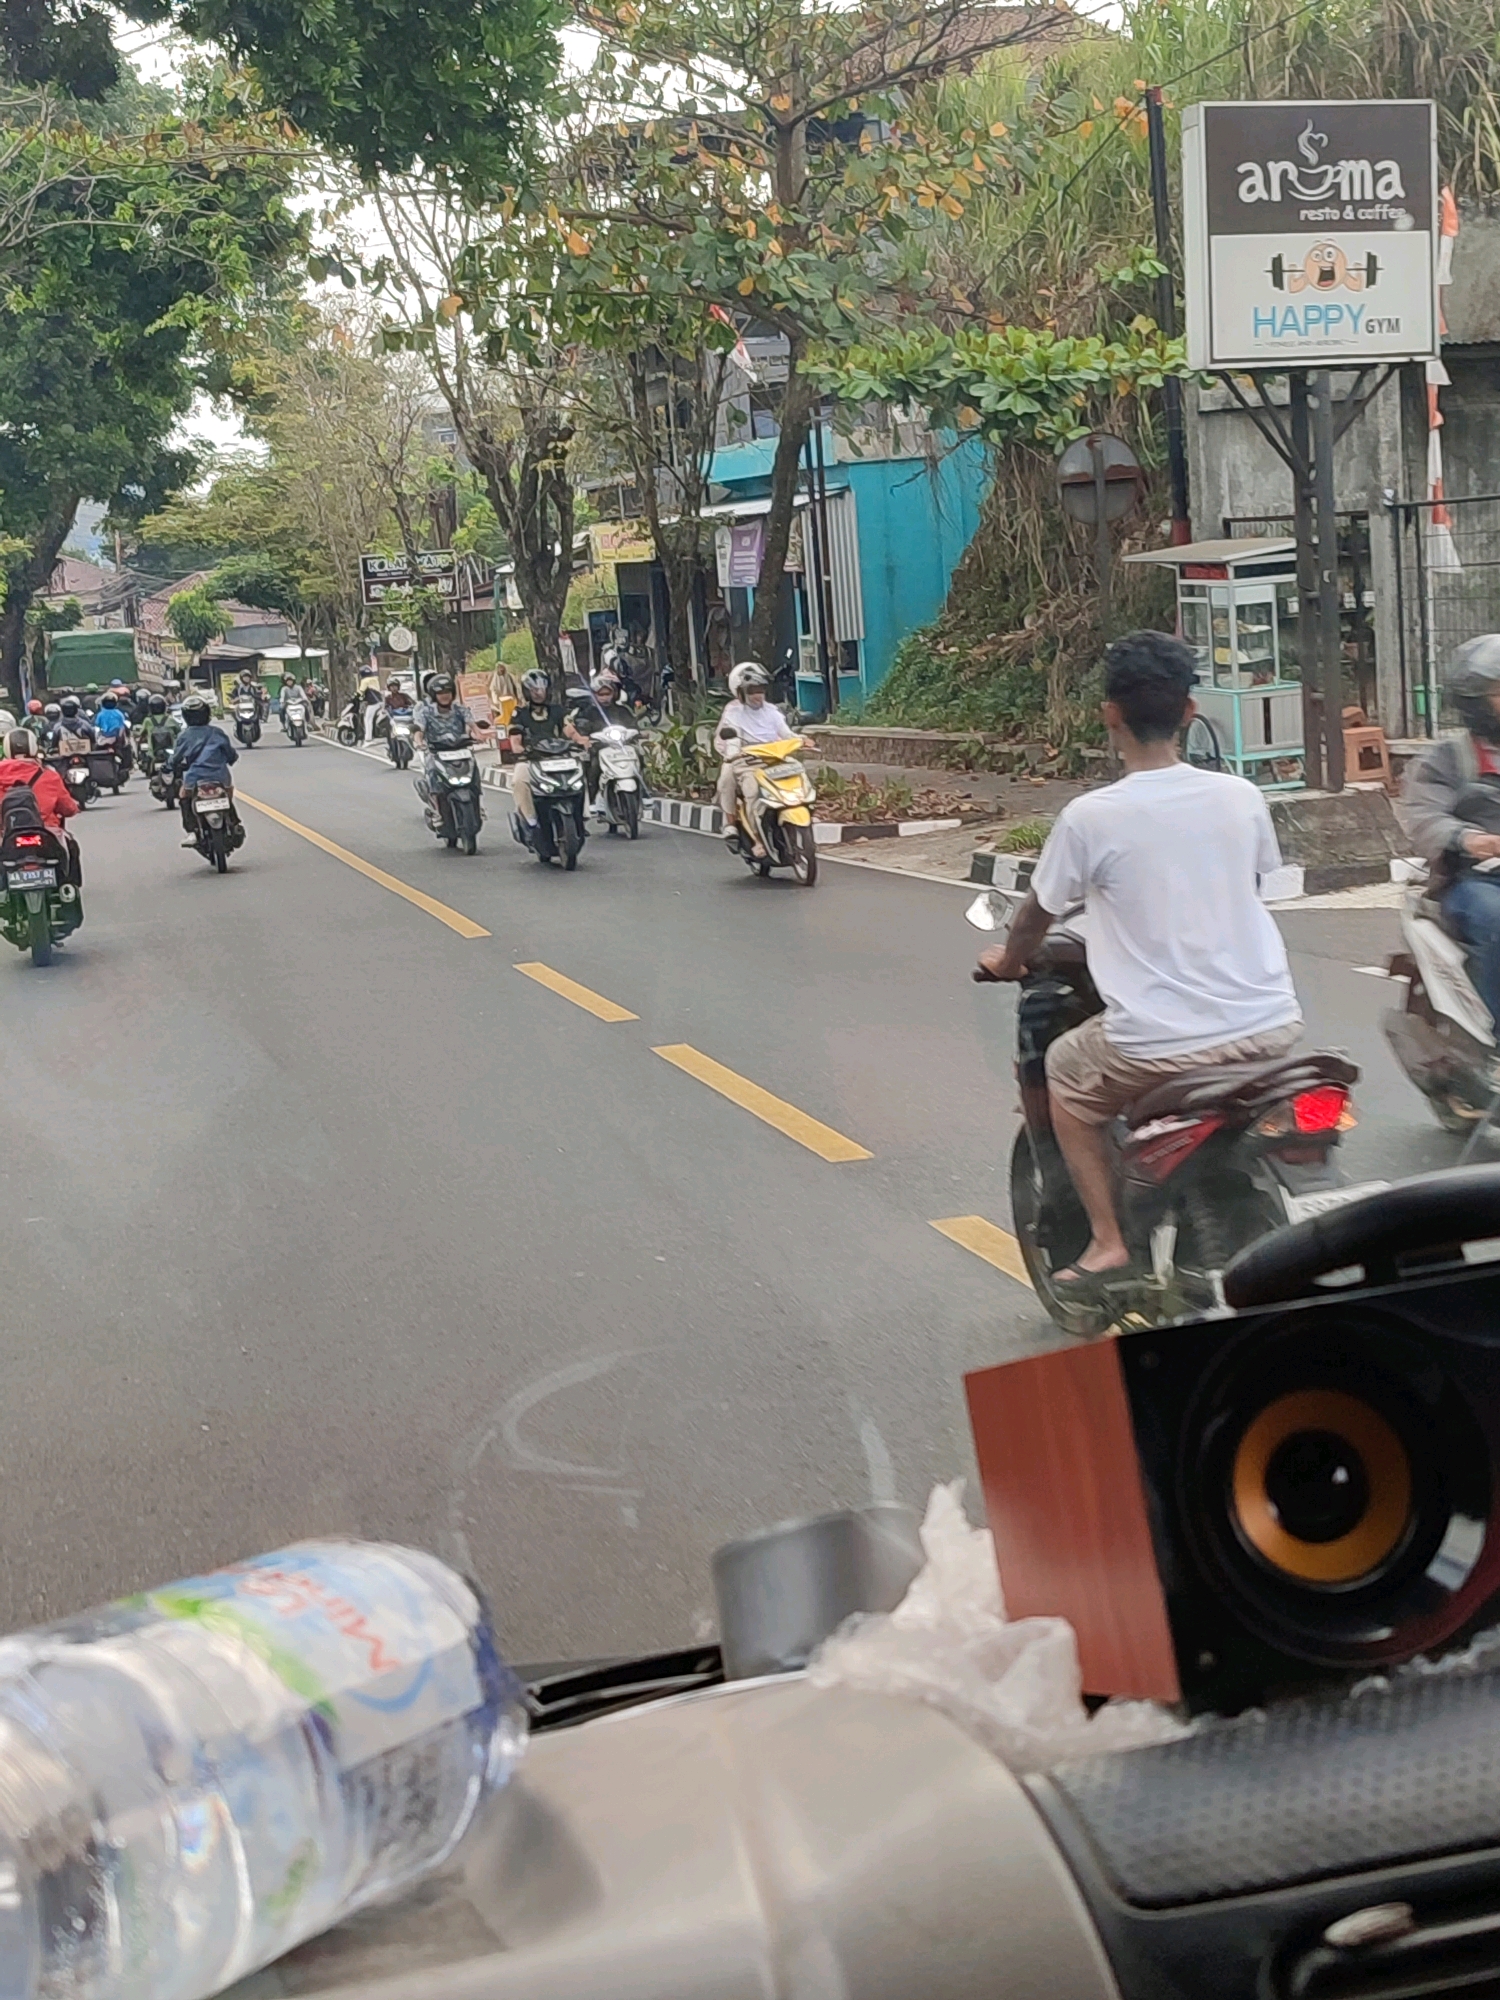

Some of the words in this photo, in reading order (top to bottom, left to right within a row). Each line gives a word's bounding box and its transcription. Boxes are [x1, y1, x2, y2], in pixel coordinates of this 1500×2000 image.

[1236, 159, 1406, 203] aroma
[1299, 206, 1340, 221] resto
[1342, 204, 1355, 220] &
[1357, 203, 1407, 220] coffee
[1253, 303, 1365, 338] HAPPY
[1365, 318, 1401, 334] GYM
